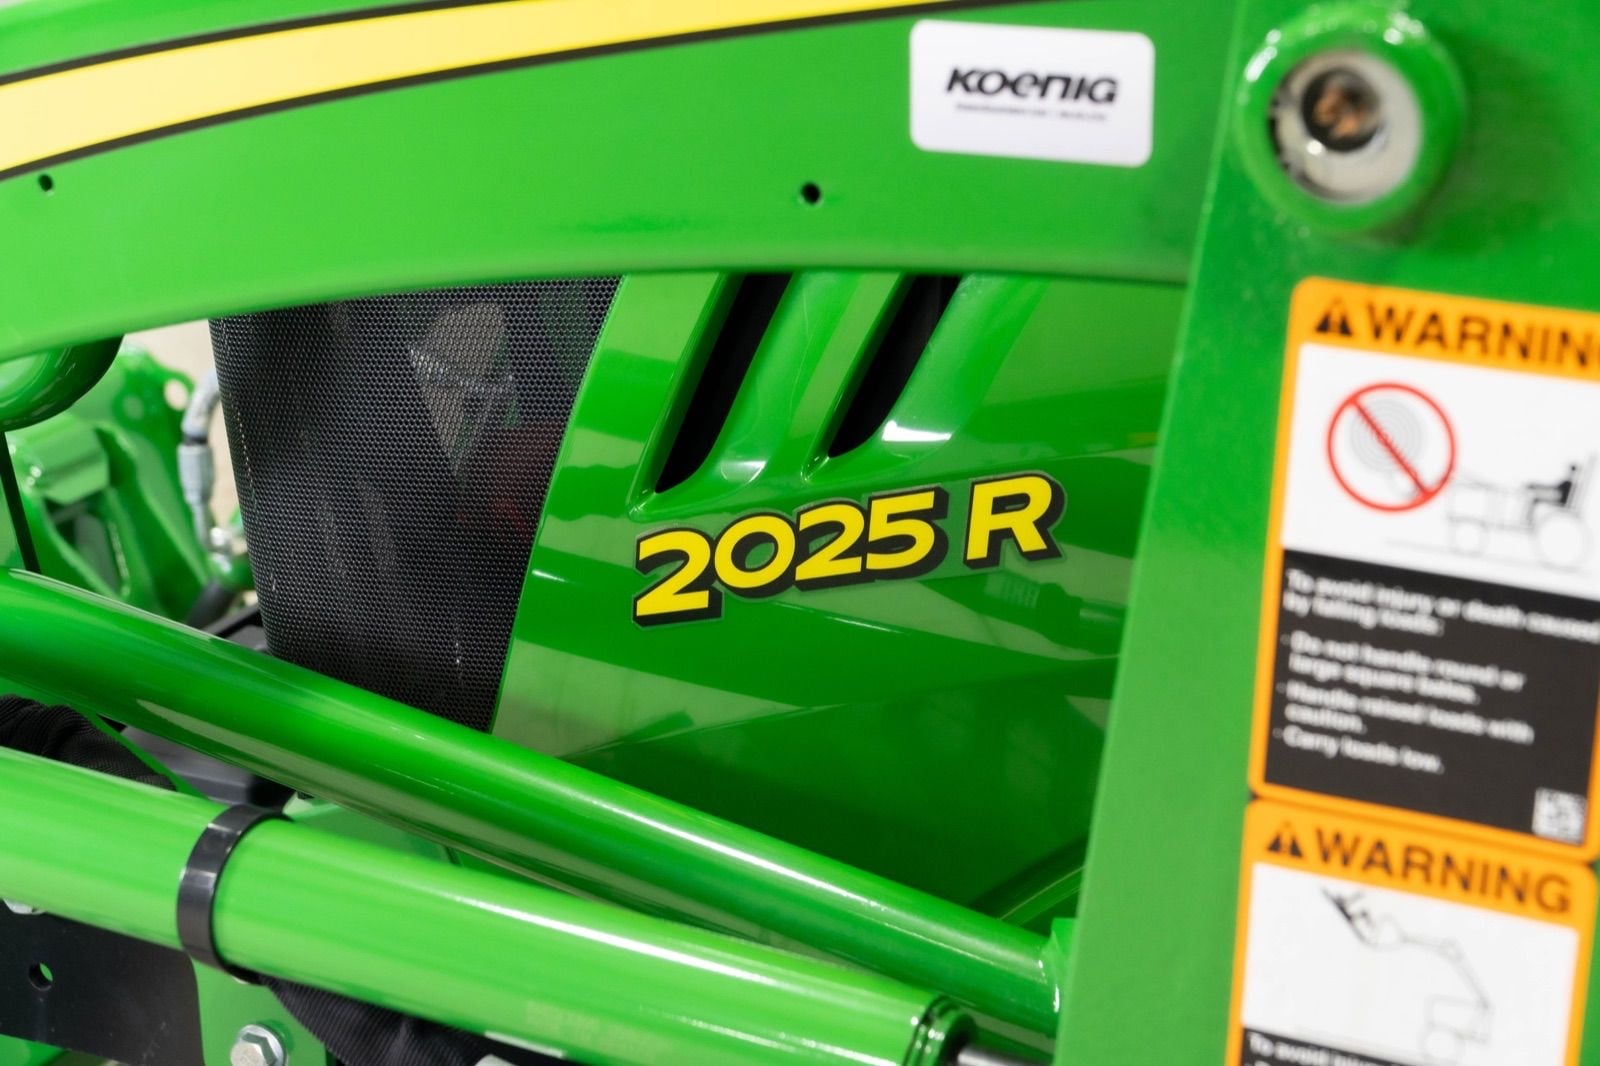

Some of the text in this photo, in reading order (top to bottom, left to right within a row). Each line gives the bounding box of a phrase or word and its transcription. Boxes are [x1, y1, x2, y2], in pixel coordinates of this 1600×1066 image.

[1367, 302, 1600, 368] WARNIN
[633, 471, 1066, 627] 2025 R
[1283, 590, 1310, 617] by
[1287, 569, 1314, 594] To
[1315, 577, 1374, 603] avoid
[1376, 585, 1433, 616] injury
[1435, 597, 1461, 618] or
[1463, 599, 1524, 629] death
[1289, 652, 1342, 681] large
[1343, 663, 1414, 692] square
[1291, 630, 1526, 692] Do not handle round or
[1284, 703, 1367, 734] caution.
[1287, 680, 1534, 745] Handle raised loads with
[1283, 725, 1445, 774] Carry loads low.
[1316, 827, 1571, 914] WARNING
[1249, 1032, 1274, 1057] To
